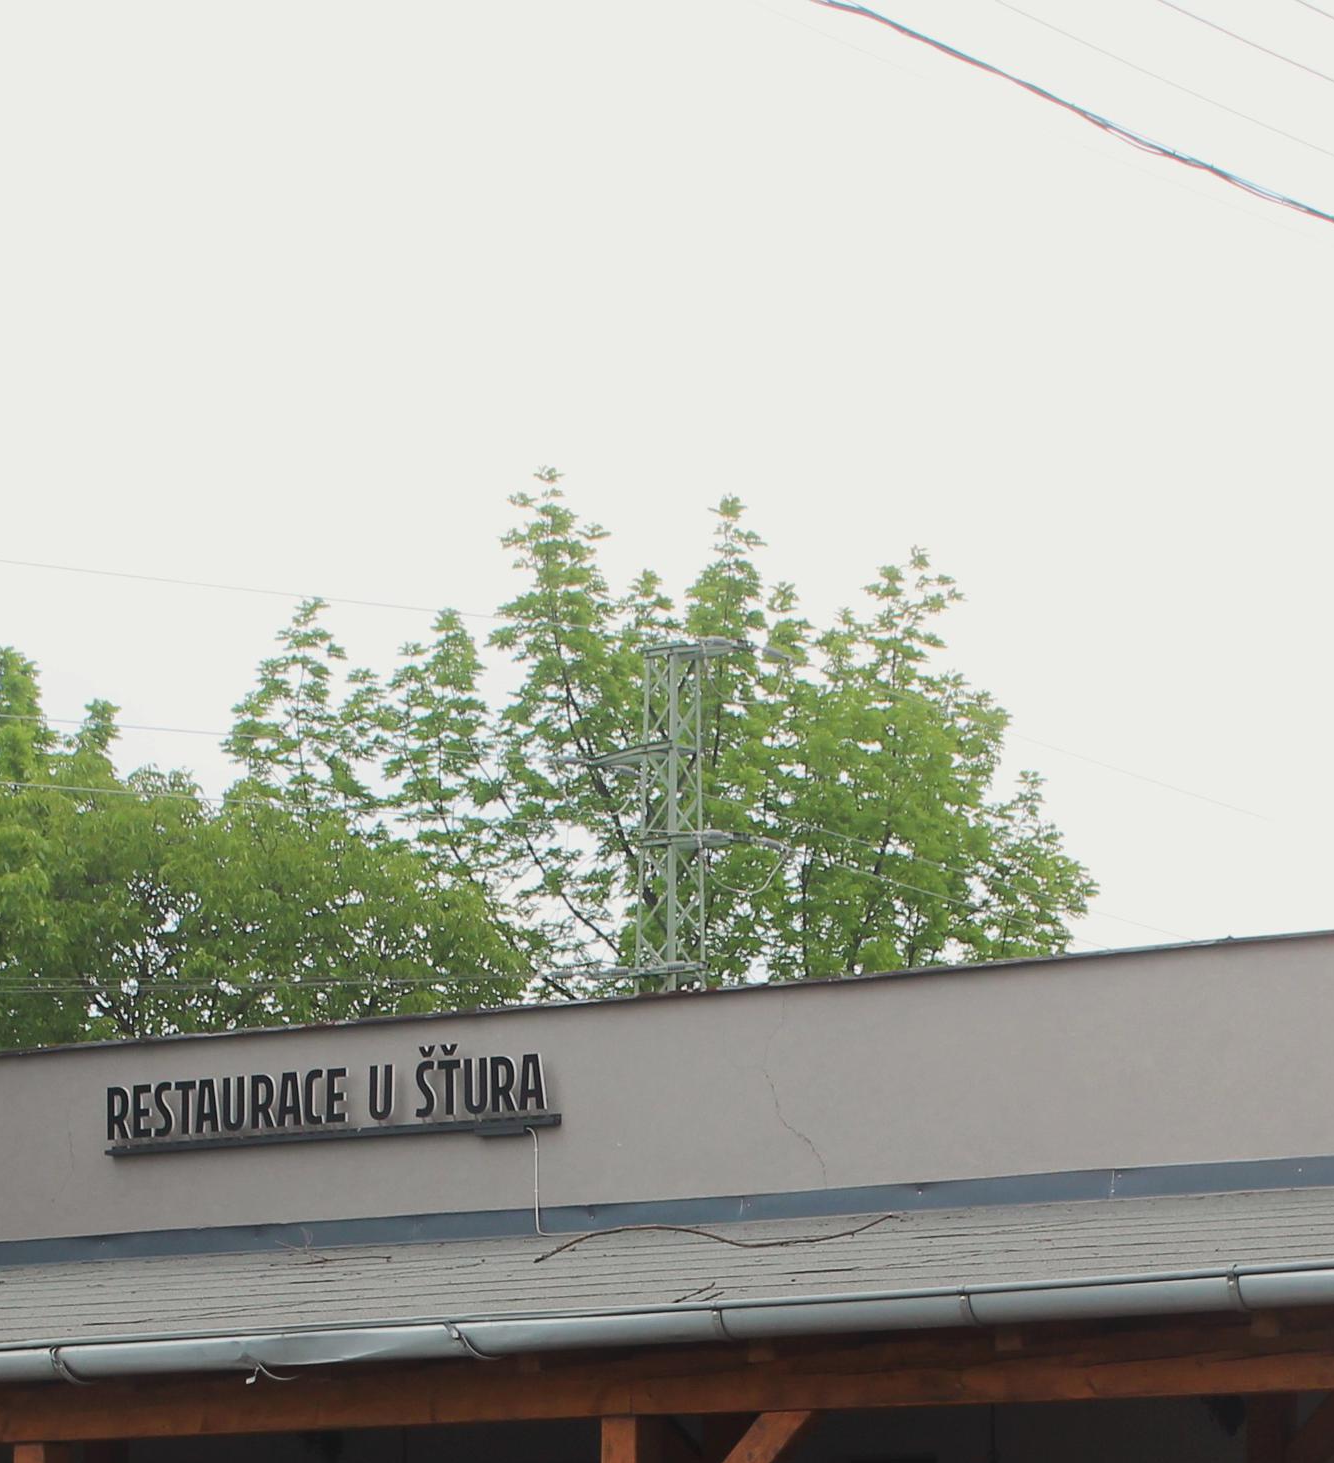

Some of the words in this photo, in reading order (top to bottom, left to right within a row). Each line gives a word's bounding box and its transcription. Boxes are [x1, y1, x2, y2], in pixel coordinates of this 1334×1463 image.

[107, 1067, 349, 1141] RESTAURACE
[369, 1064, 395, 1121] U
[415, 1043, 547, 1119] ŠŤURA
